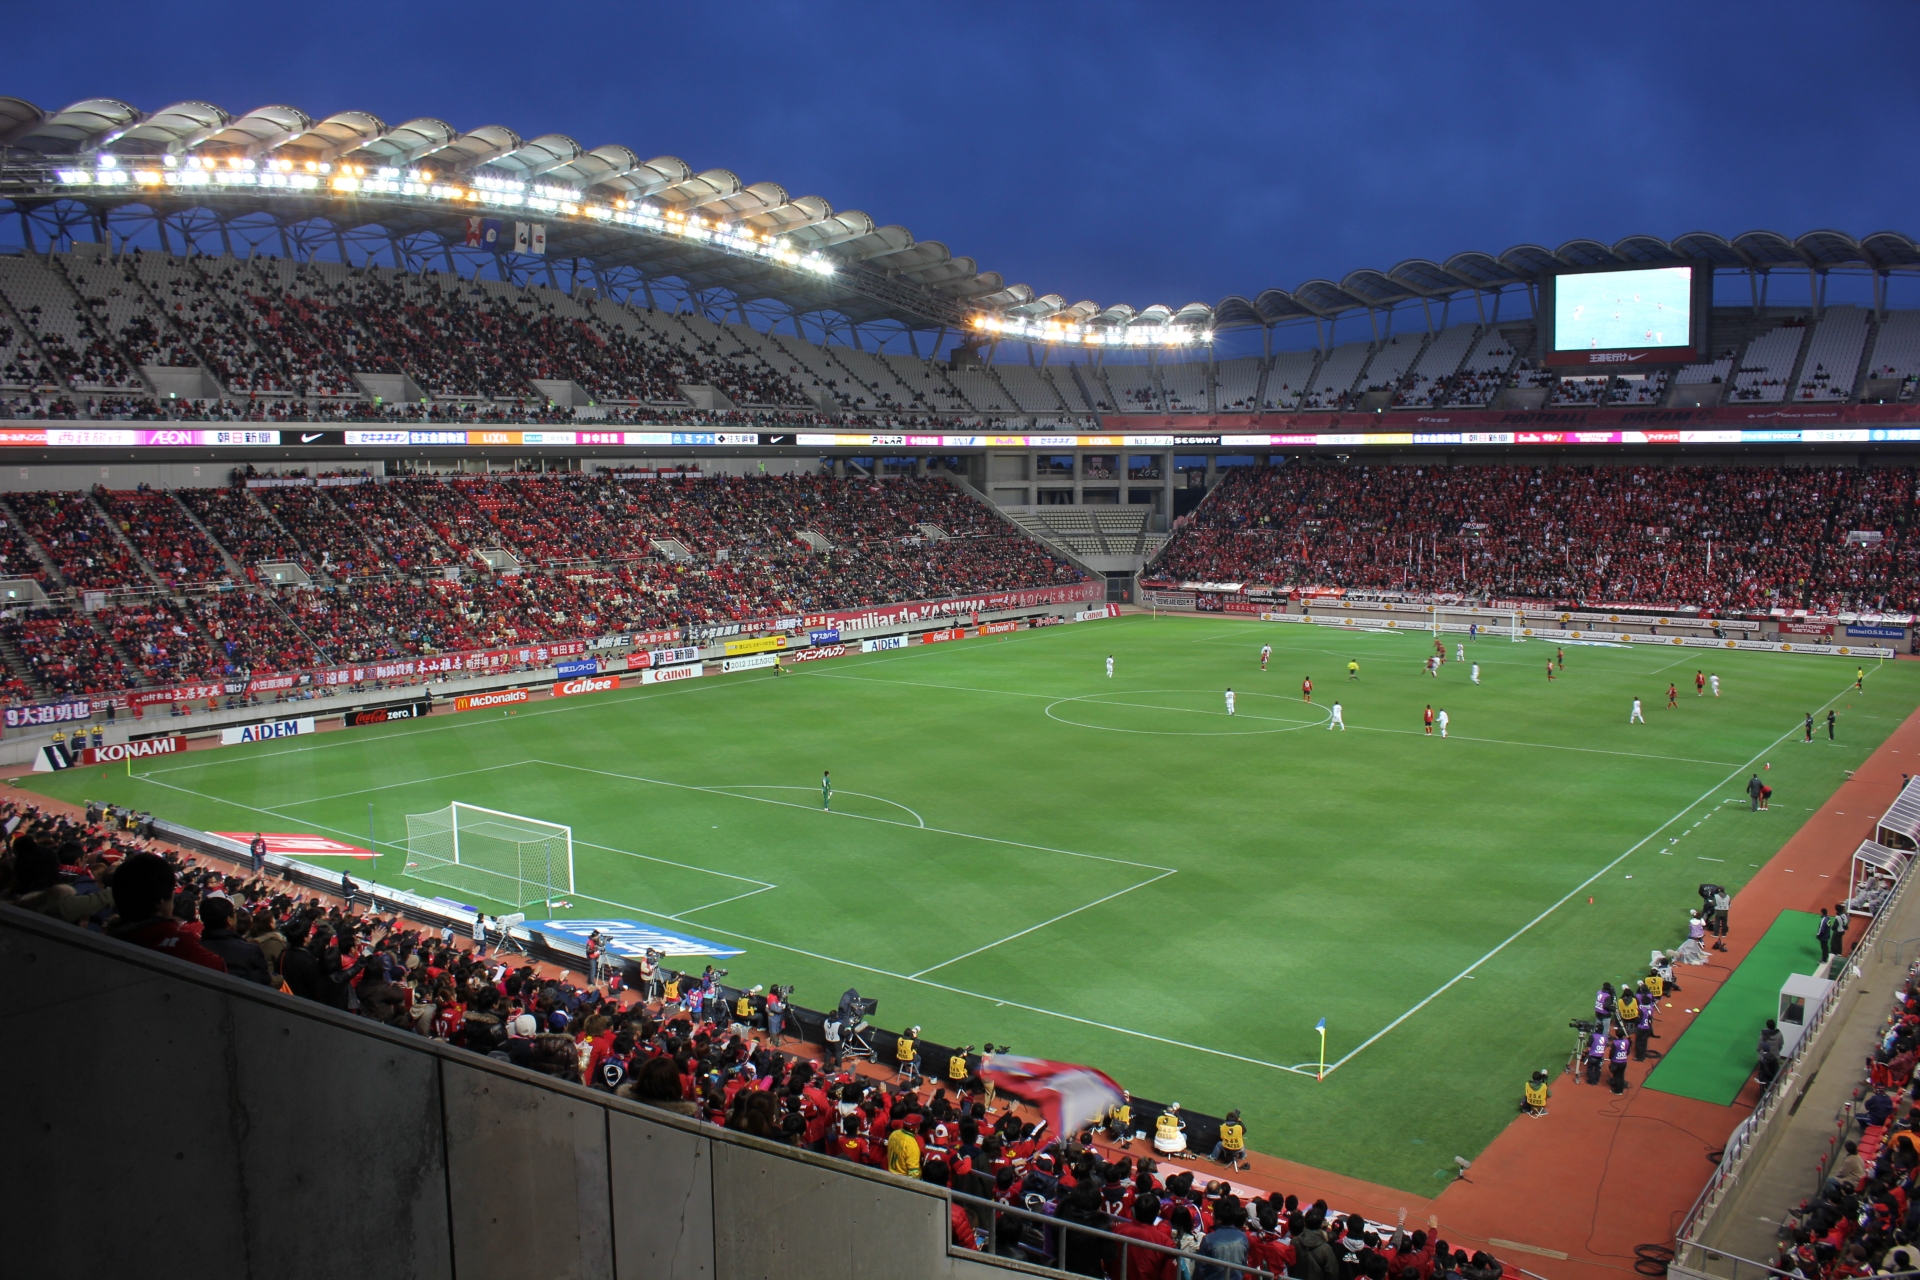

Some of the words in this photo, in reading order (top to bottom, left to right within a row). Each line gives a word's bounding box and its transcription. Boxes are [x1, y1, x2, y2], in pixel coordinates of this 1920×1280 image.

[217, 432, 272, 444] 朝日新聞
[482, 433, 509, 444] LIXIL
[826, 612, 896, 632] Familiar
[899, 608, 919, 624] de
[920, 599, 986, 620] KASHIMA
[1082, 610, 1103, 621] Canon
[796, 646, 846, 662] ウイニングイレブン
[416, 656, 463, 674] 本山雅志
[558, 663, 596, 674] 東京エレクトロン
[731, 660, 746, 669] 2012
[315, 674, 324, 685] 25
[367, 668, 376, 679] 27
[654, 666, 692, 682] Canon
[562, 679, 612, 696] Calbee
[470, 691, 527, 708] McDonald's
[387, 710, 408, 720] zero
[241, 720, 298, 743] AiDEM
[94, 738, 176, 762] KONAMI
[1105, 1200, 1123, 1216] 12
